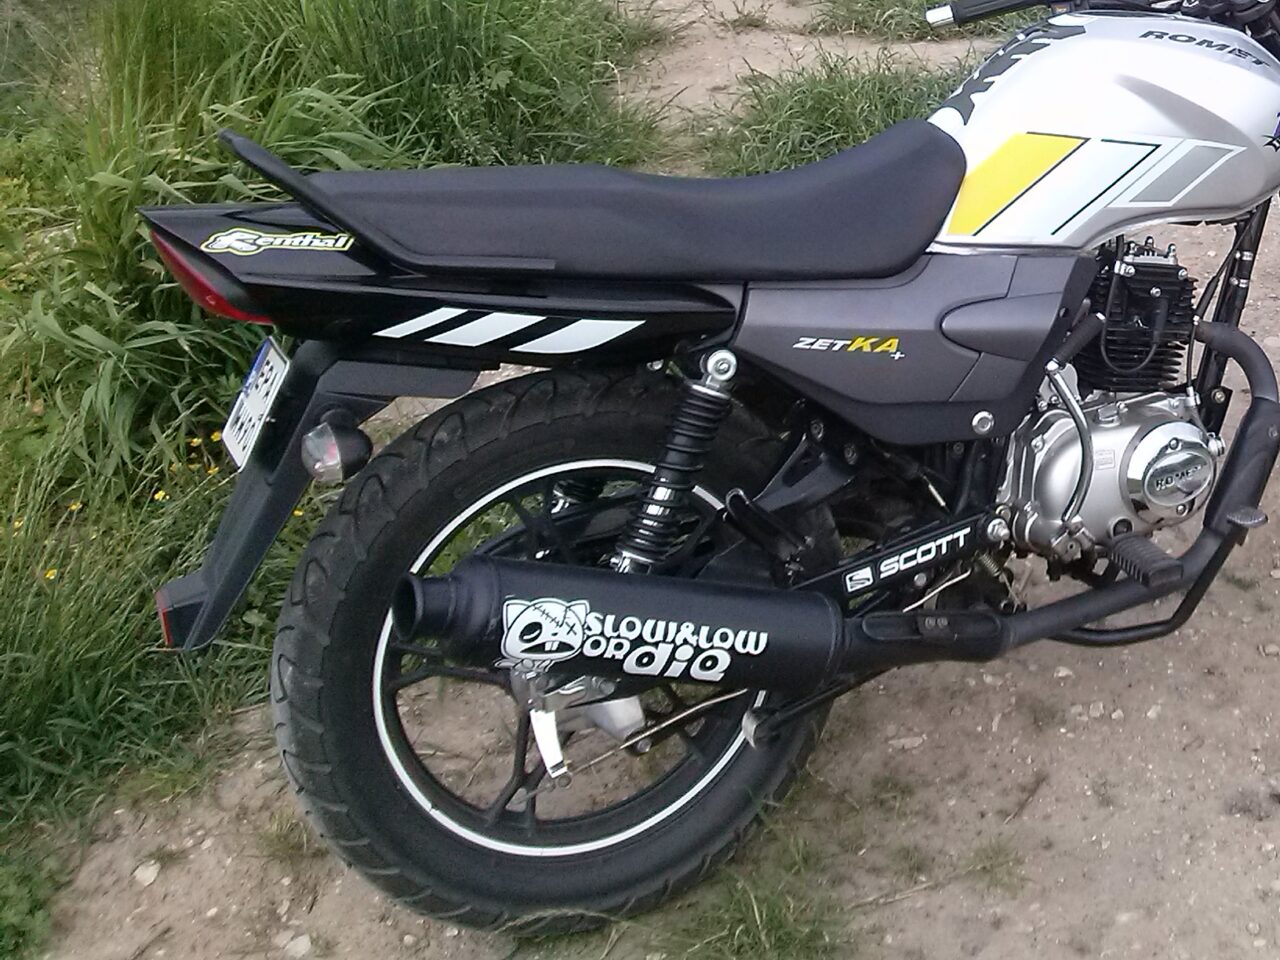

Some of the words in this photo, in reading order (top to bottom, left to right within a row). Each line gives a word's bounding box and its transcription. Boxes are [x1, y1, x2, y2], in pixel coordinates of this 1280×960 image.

[1139, 29, 1270, 68] ROMET
[205, 229, 352, 254] Renthal
[879, 526, 971, 580] SCOTT
[582, 635, 631, 660] OR
